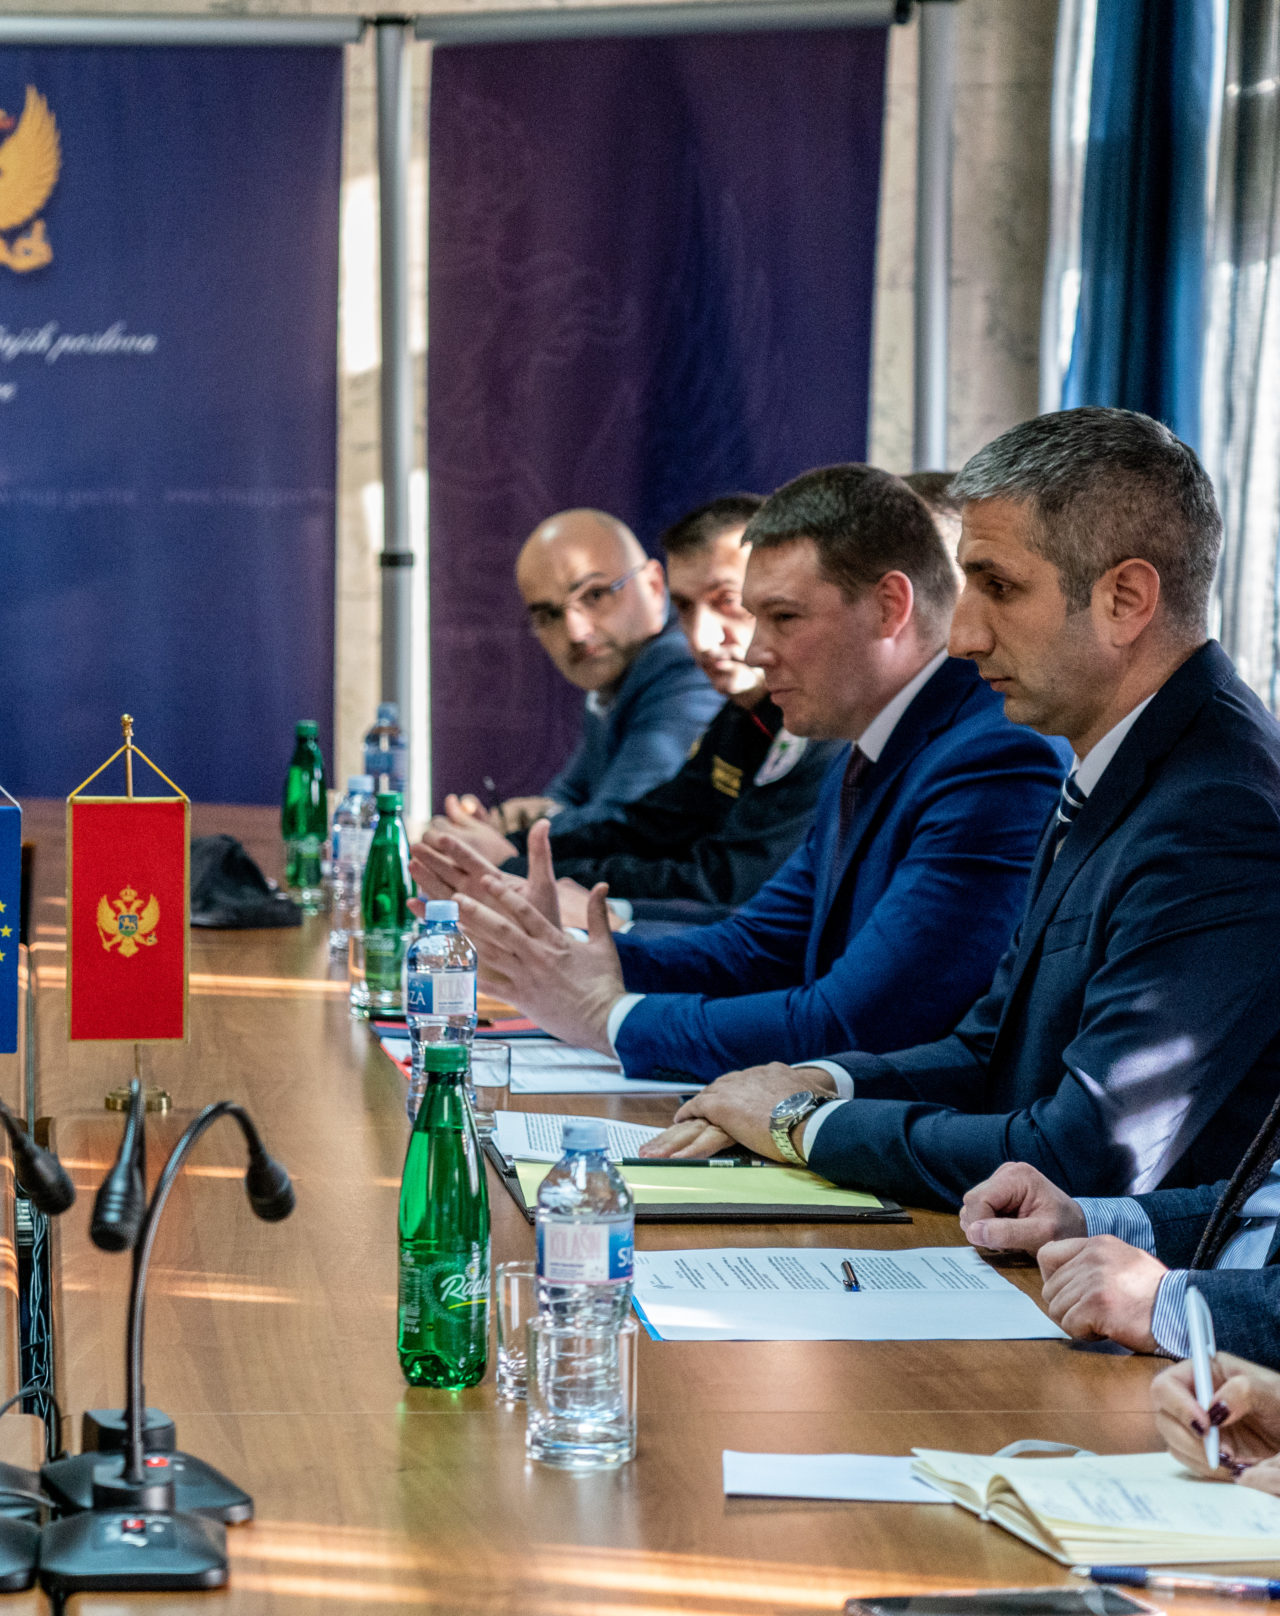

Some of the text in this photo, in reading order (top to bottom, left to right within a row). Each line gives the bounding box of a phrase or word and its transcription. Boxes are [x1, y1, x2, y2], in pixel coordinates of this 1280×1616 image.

[45, 320, 158, 363] poslova
[408, 990, 426, 1006] ZA
[617, 1247, 634, 1267] SU
